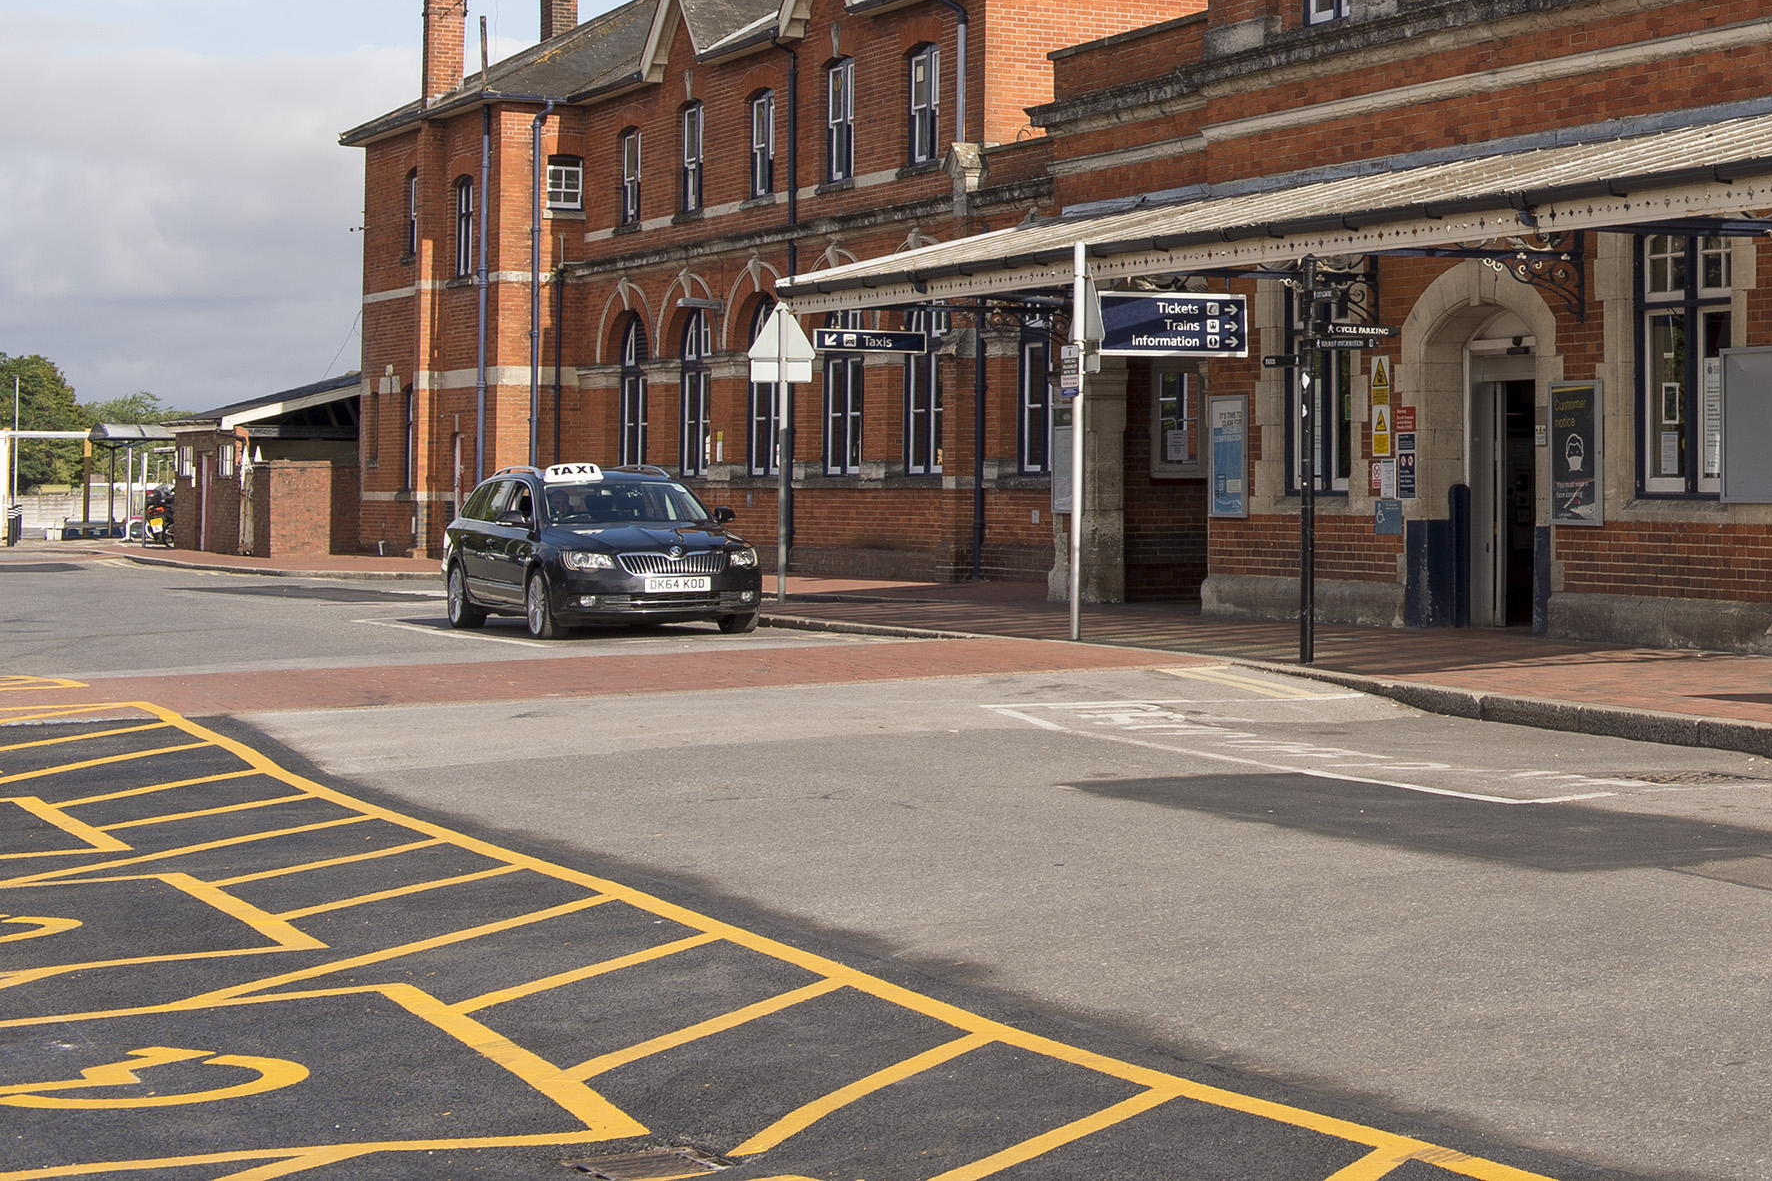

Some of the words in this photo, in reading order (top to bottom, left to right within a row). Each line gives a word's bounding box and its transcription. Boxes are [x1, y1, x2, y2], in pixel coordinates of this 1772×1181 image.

[1157, 302, 1199, 314] Tickets
[1164, 319, 1200, 331] Trains
[1335, 325, 1357, 334] CYCLE
[1358, 326, 1389, 335] PARKING
[862, 335, 893, 348] Taxis
[1132, 334, 1200, 347] Information
[1554, 399, 1587, 412] Customer
[1554, 417, 1576, 428] notice
[550, 465, 595, 476] TAXI
[650, 578, 680, 590] DK64
[684, 578, 705, 589] KOD
